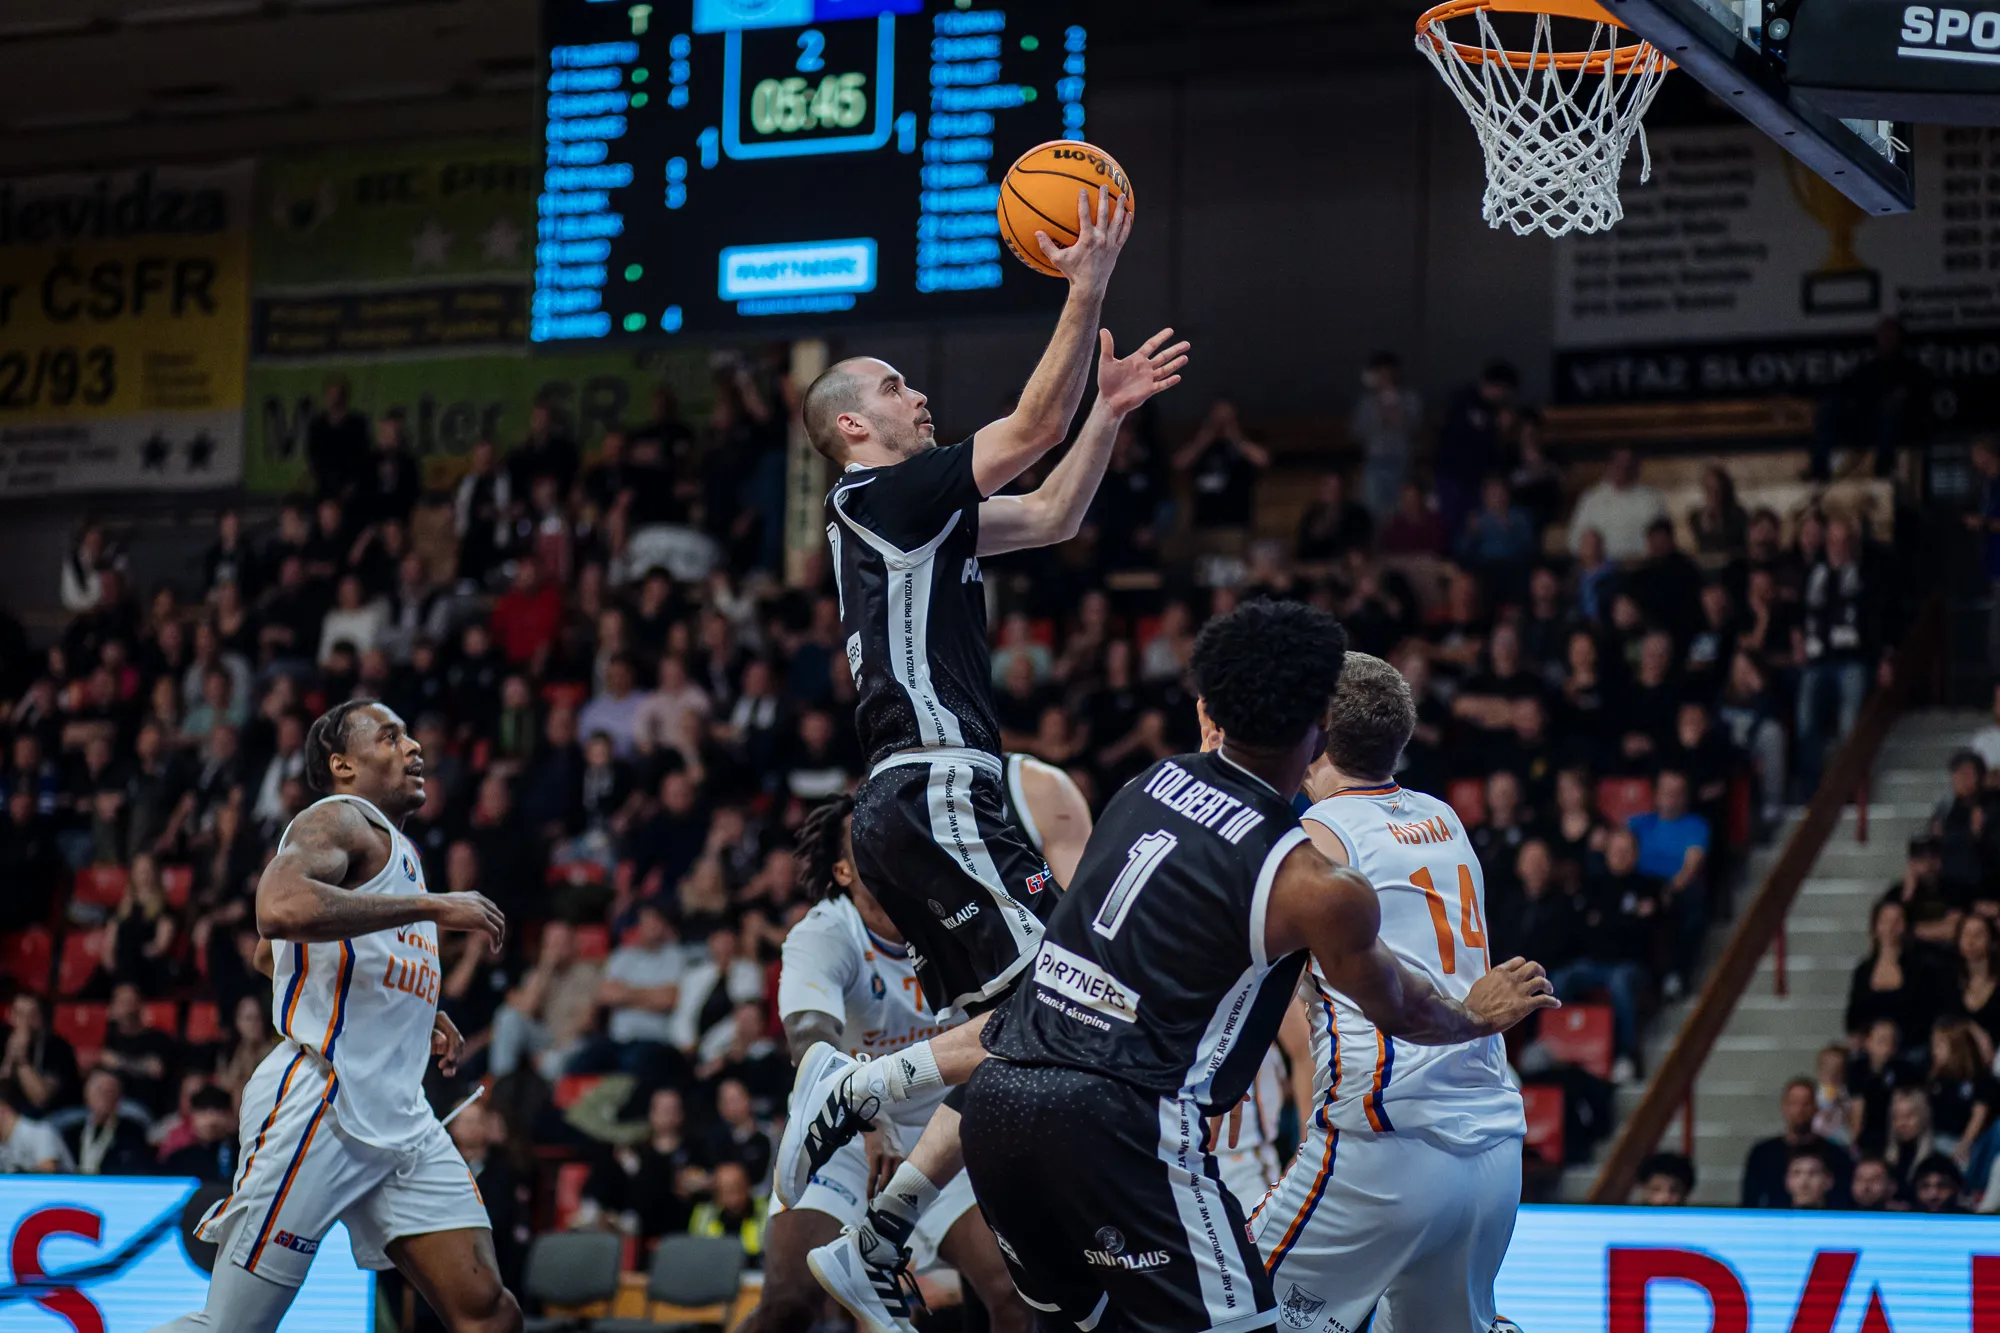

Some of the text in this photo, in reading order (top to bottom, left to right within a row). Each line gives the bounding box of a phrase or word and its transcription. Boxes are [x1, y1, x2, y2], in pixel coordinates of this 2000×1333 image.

[796, 28, 825, 72] 2
[904, 577, 914, 618] PRIEVIDZA
[904, 619, 914, 635] ARE
[1143, 761, 1265, 845] TOLBERT III
[1092, 829, 1178, 941] 1
[1409, 863, 1493, 975] 14
[1065, 1006, 1112, 1032] skupina
[1209, 989, 1249, 1070] WE ARE PRIEVIDZA
[1180, 1118, 1190, 1137] ARE
[1199, 1206, 1211, 1222] WE
[1222, 1274, 1233, 1292] ARE
[1226, 1293, 1237, 1309] WE
